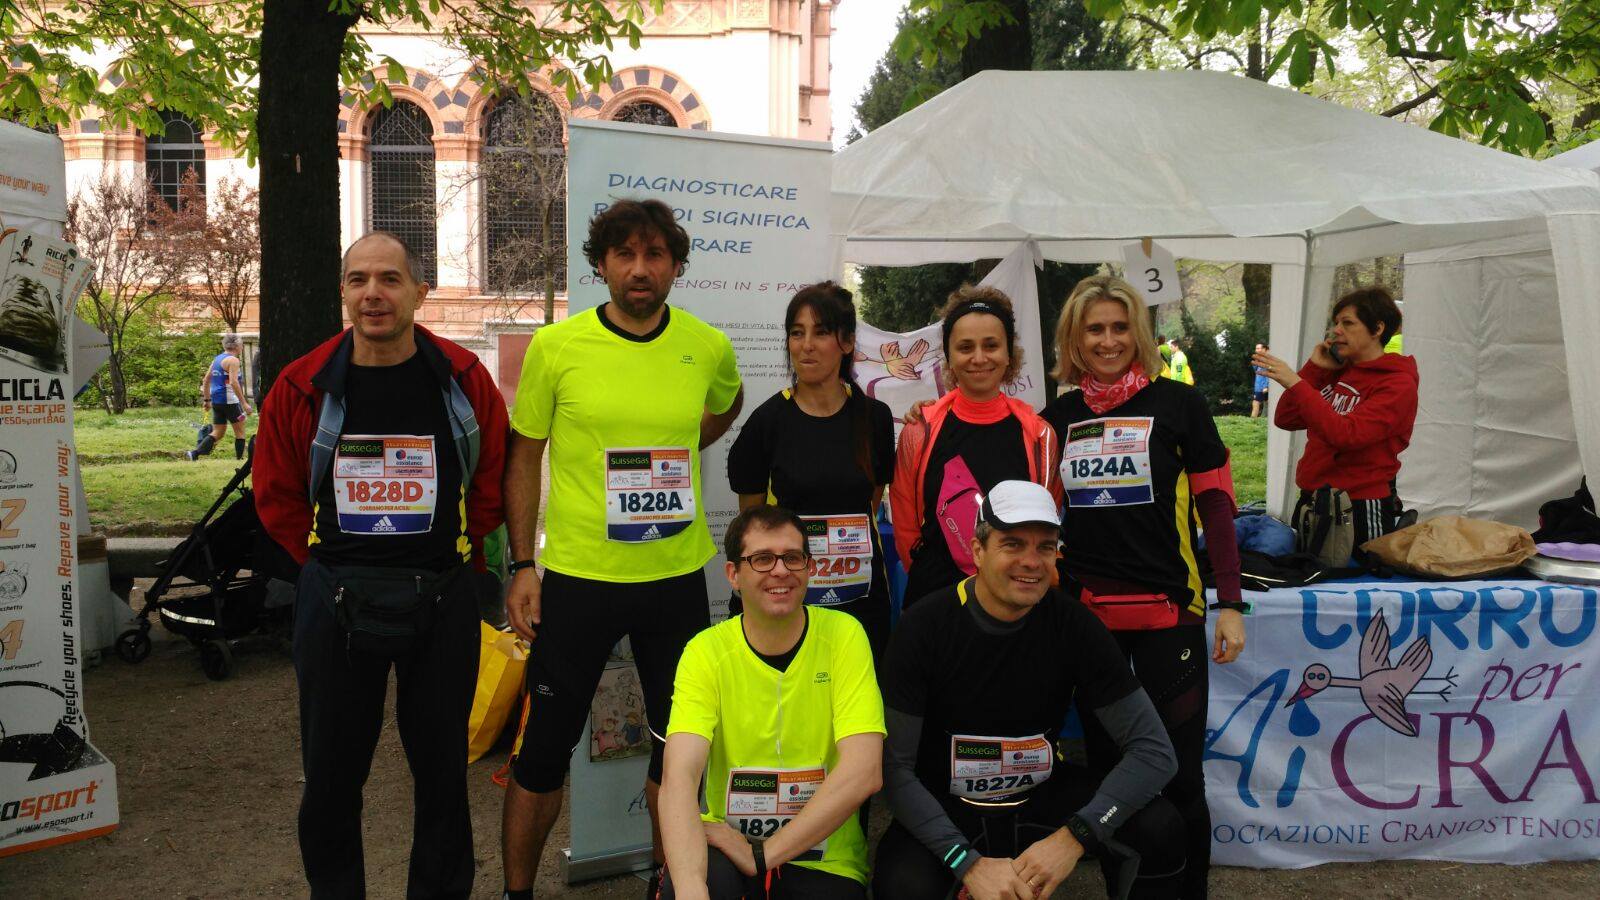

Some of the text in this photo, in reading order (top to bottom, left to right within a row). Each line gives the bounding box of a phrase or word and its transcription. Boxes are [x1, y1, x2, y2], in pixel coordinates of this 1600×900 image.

[13, 177, 30, 190] your
[608, 173, 798, 201] DIAGNOSTICARE
[703, 210, 811, 230] SIGNIFICA
[734, 281, 751, 291] IN
[1144, 267, 1164, 293] 3
[17, 404, 65, 417] scarpe
[1069, 455, 1138, 479] 1824A
[58, 483, 73, 517] your
[346, 481, 424, 503] 1828D
[618, 491, 684, 513] 1828A
[58, 521, 74, 578] Repave
[60, 581, 74, 628] shoes.
[63, 631, 77, 665] your
[62, 669, 78, 726] Recycle
[1466, 658, 1582, 724] per
[965, 774, 1035, 793] 1827A
[16, 811, 94, 835] www.esosport.it
